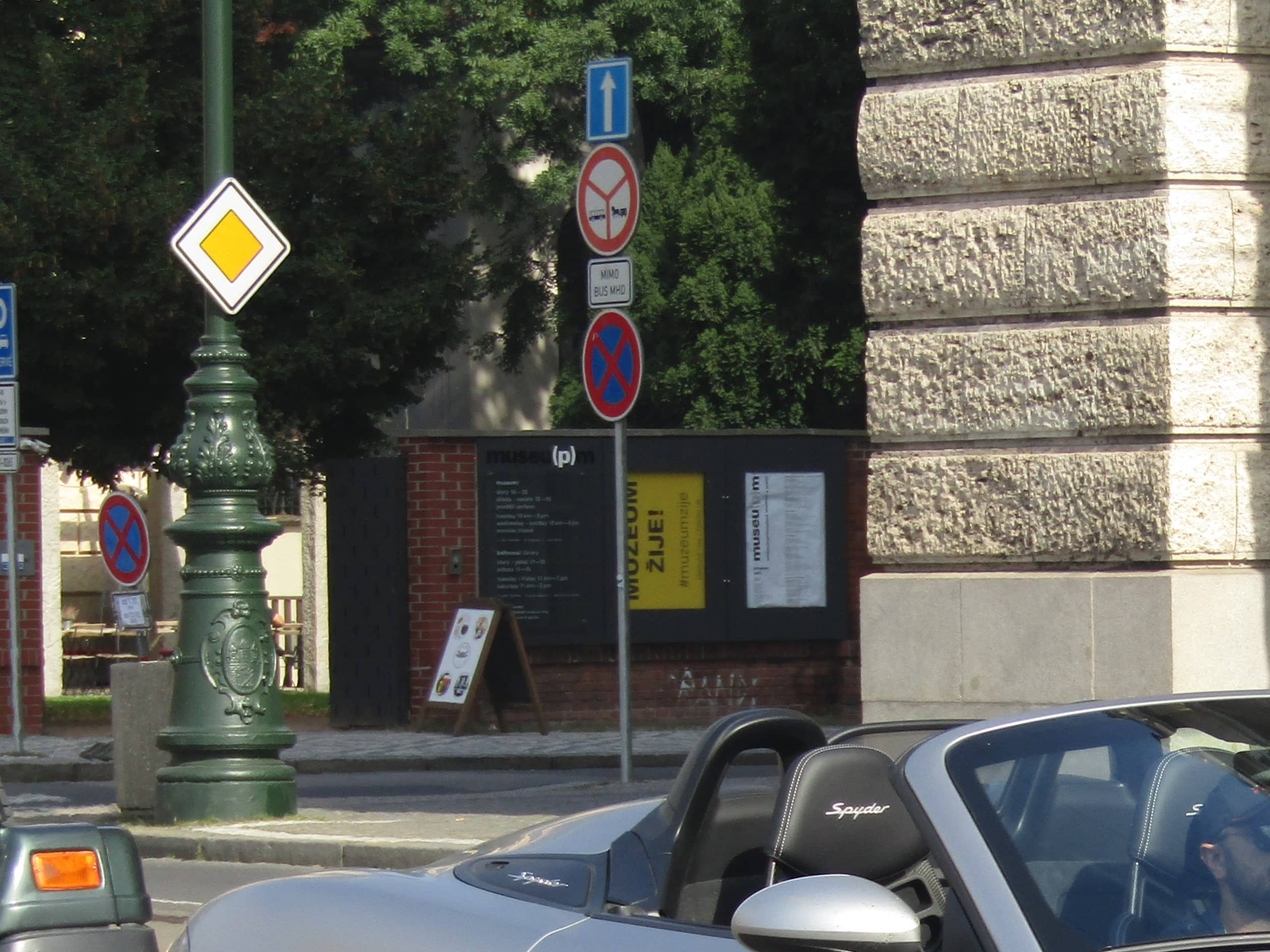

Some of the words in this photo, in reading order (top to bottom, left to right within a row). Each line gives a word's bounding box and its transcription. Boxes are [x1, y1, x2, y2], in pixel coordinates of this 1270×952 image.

[600, 268, 619, 280] MIMO
[594, 285, 608, 297] BUS
[610, 284, 626, 296] MHD
[646, 509, 664, 573] ŽIJE!
[825, 802, 890, 820] Spyder
